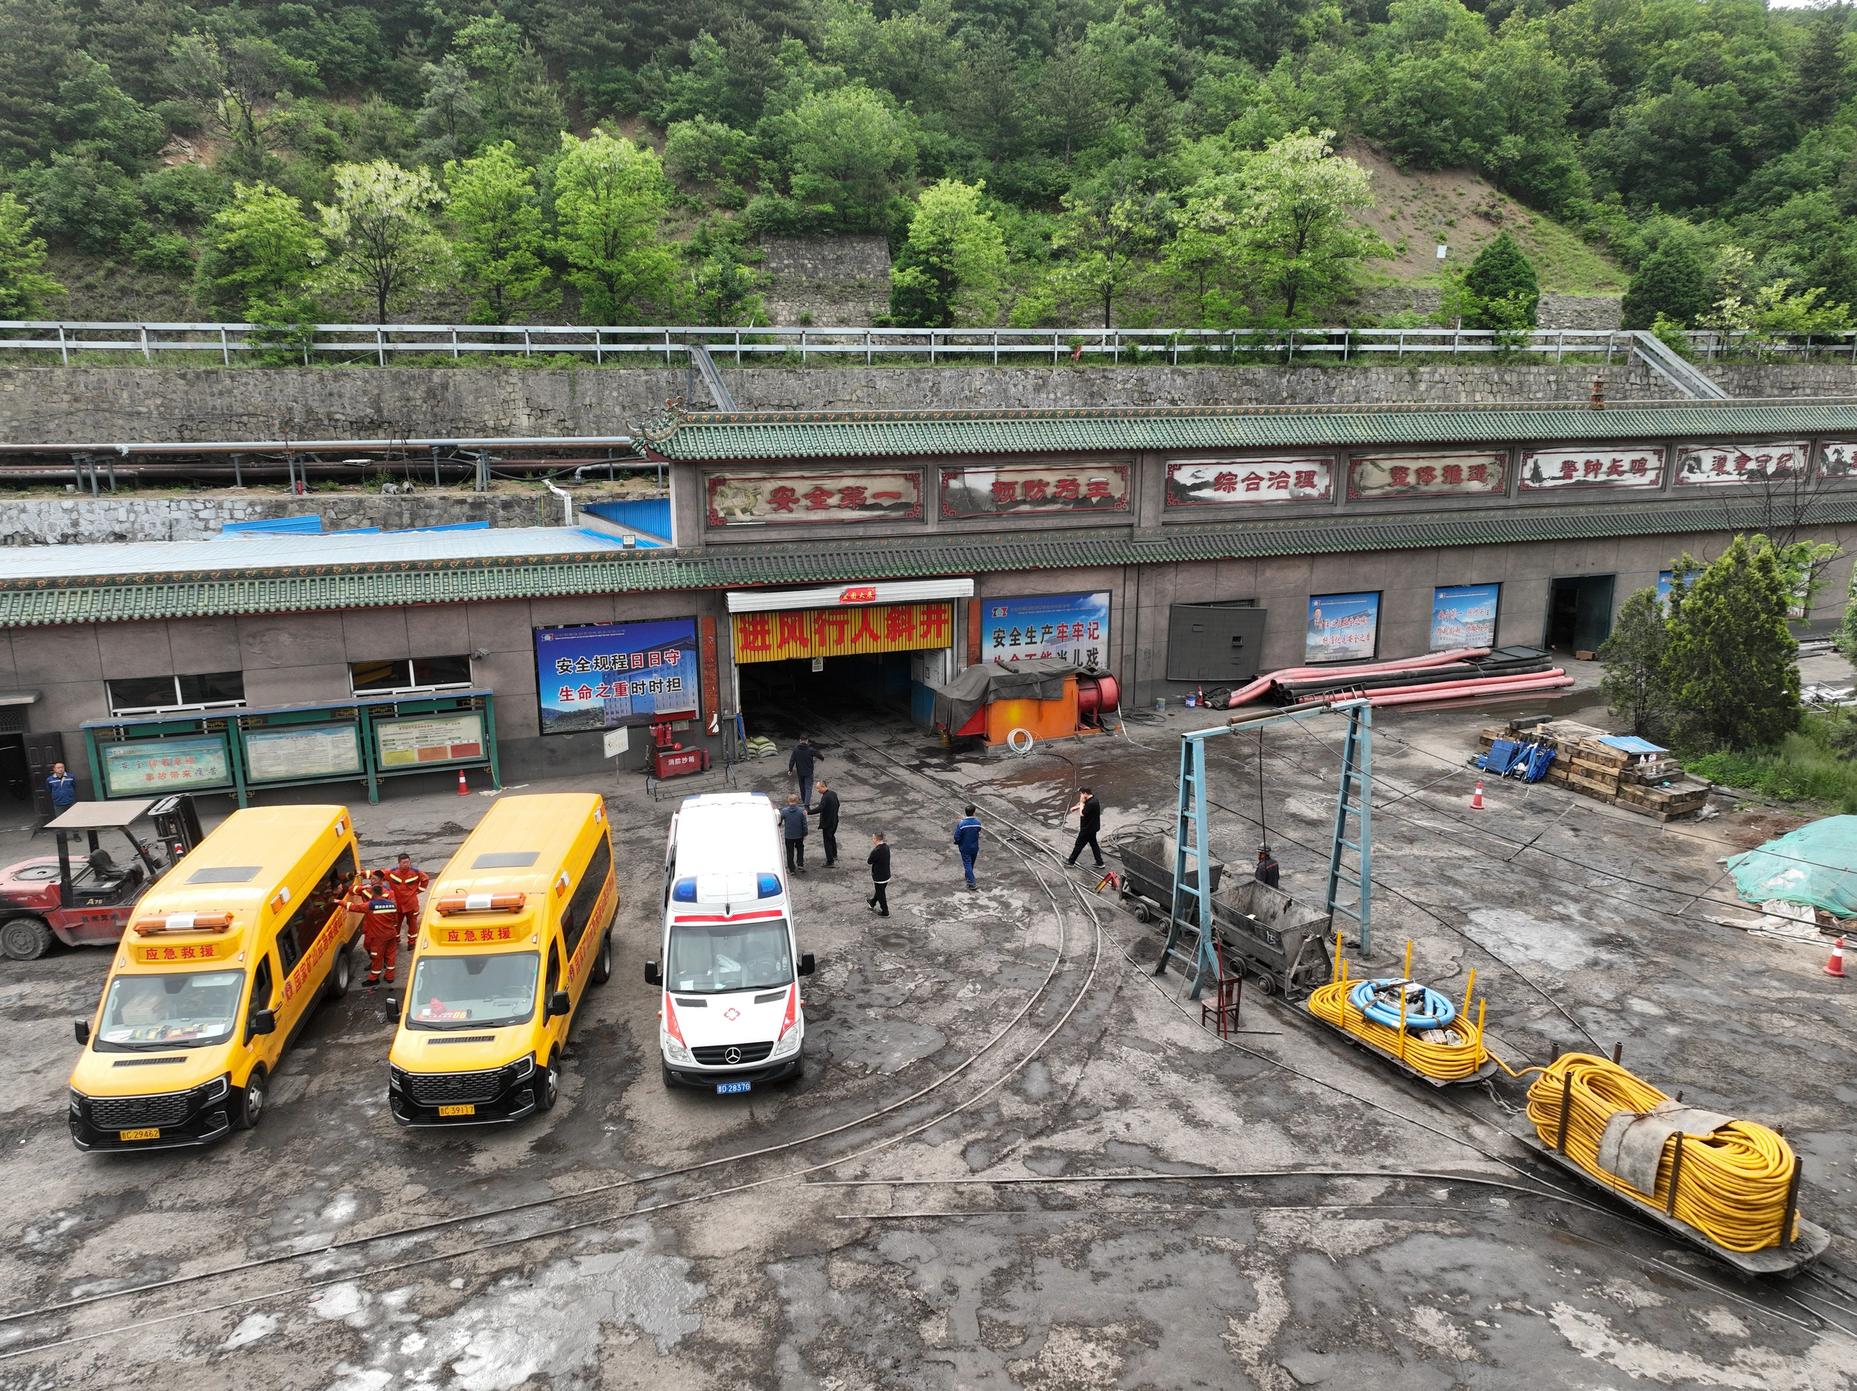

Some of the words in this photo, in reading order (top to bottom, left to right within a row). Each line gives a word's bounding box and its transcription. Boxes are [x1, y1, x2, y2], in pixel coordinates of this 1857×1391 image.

[1213, 470, 1318, 493] 综合治理
[1560, 457, 1649, 480] 警钟长鸣
[767, 484, 903, 513] 安全第一
[992, 477, 1111, 505] 预防为主
[738, 604, 949, 652] 进风行人斜井
[993, 621, 1100, 648] 安全生产牢牢记
[556, 649, 681, 675] 安全规程日日守
[559, 677, 683, 703] 生命之重时时担
[447, 926, 511, 943] 应急救援
[145, 944, 215, 960] 应急救援
